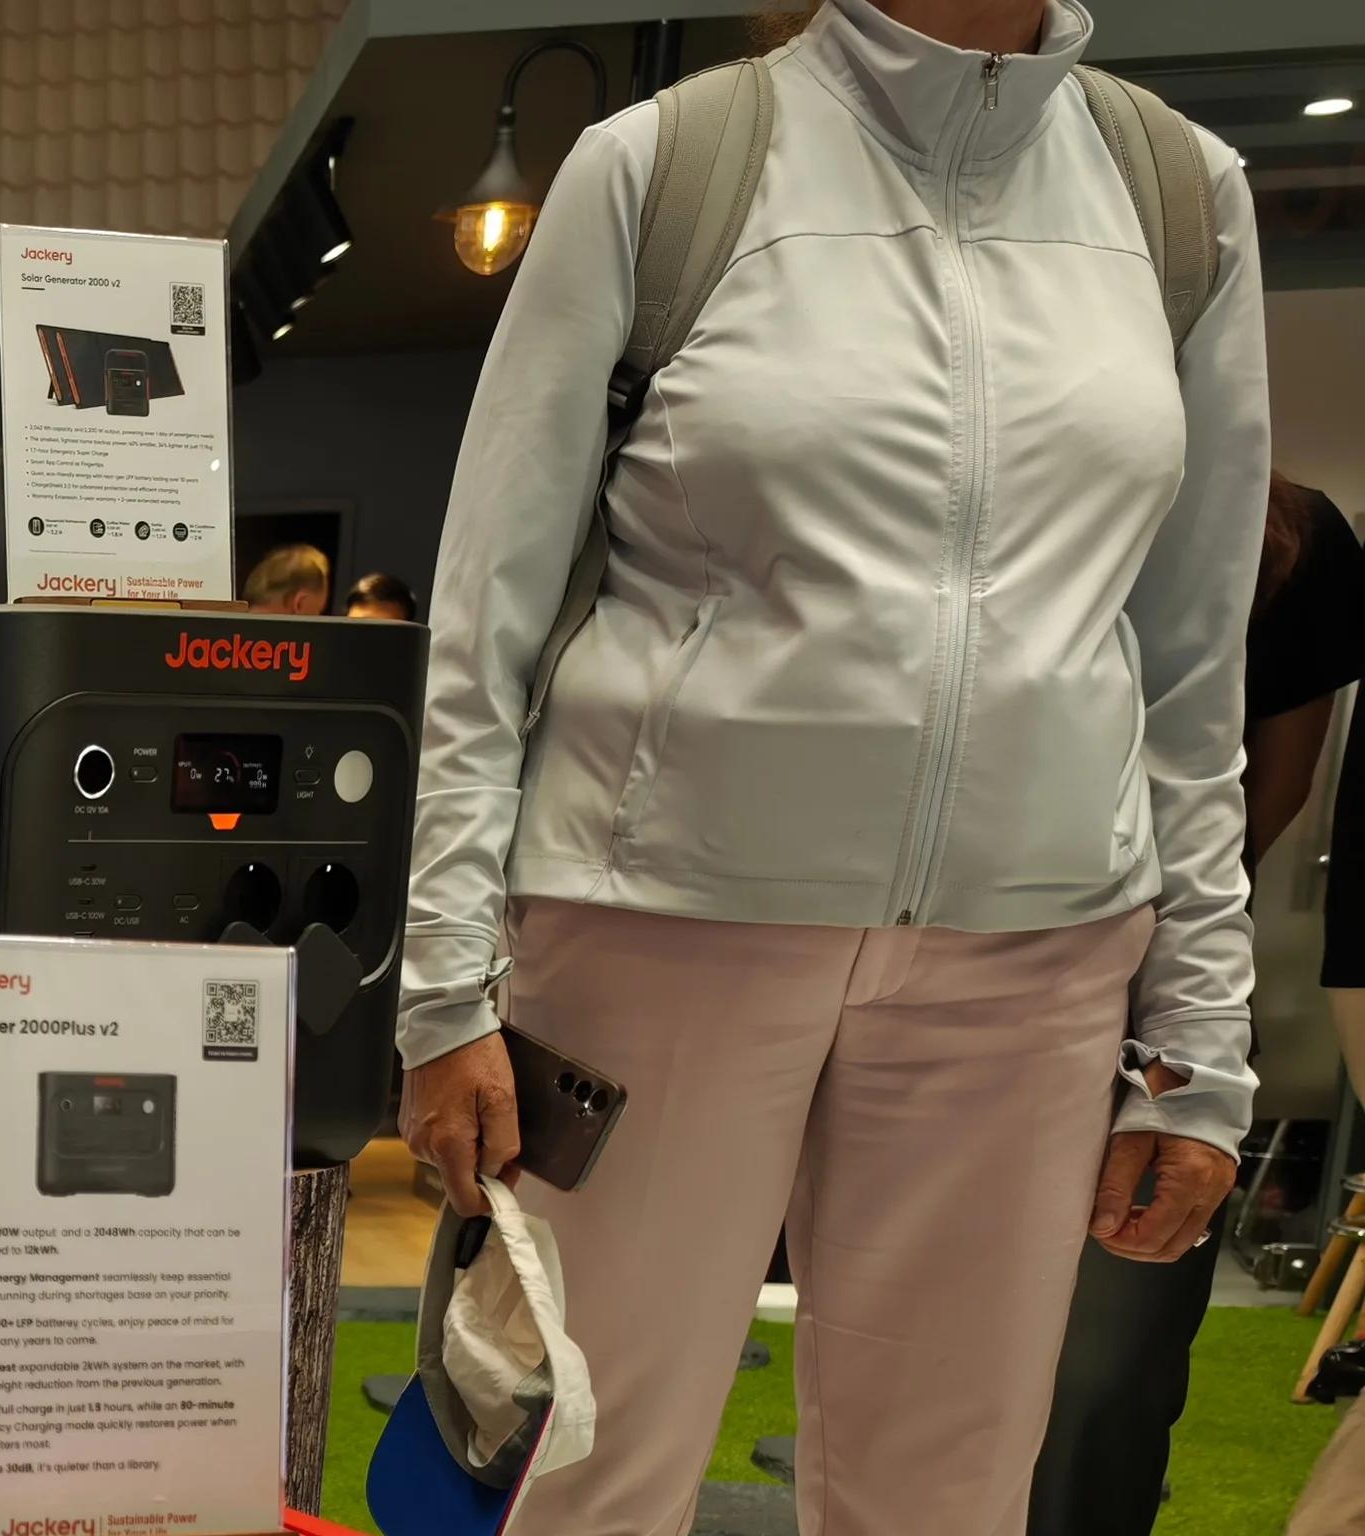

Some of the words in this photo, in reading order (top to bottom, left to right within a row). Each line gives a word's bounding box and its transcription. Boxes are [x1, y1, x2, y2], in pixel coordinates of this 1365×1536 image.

[21, 248, 72, 265] Jackery
[21, 273, 42, 282] Solar
[45, 275, 86, 285] Generator
[89, 278, 109, 286] 2000
[37, 574, 116, 596] Jackery
[127, 577, 175, 587] Sustainable
[177, 578, 203, 588] Power
[165, 632, 310, 680] Jackery
[75, 806, 84, 814] DC
[19, 1019, 95, 1036] 2000Plus
[100, 1023, 118, 1036] v2
[61, 1228, 81, 1237] and
[94, 1227, 136, 1237] 2048Wh
[139, 1228, 181, 1239] capacity
[184, 1228, 204, 1237] that
[207, 1229, 225, 1237] can
[228, 1228, 240, 1237] be
[30, 1272, 99, 1284] Management
[103, 1273, 157, 1284] seamlessly
[187, 1272, 231, 1281] essential
[118, 1317, 145, 1328] enjoy
[148, 1317, 179, 1328] peace
[194, 1316, 219, 1326] mind
[22, 1337, 51, 1347] years
[19, 1362, 79, 1374] expandable
[25, 1380, 72, 1389] reduction
[121, 1378, 163, 1390] previous
[16, 1404, 53, 1416] charge
[137, 1401, 162, 1411] while
[14, 1422, 62, 1434] Charging
[97, 1420, 132, 1431] quickly
[177, 1419, 207, 1429] power
[108, 1514, 163, 1525] Sustainable
[168, 1513, 197, 1524] Power
